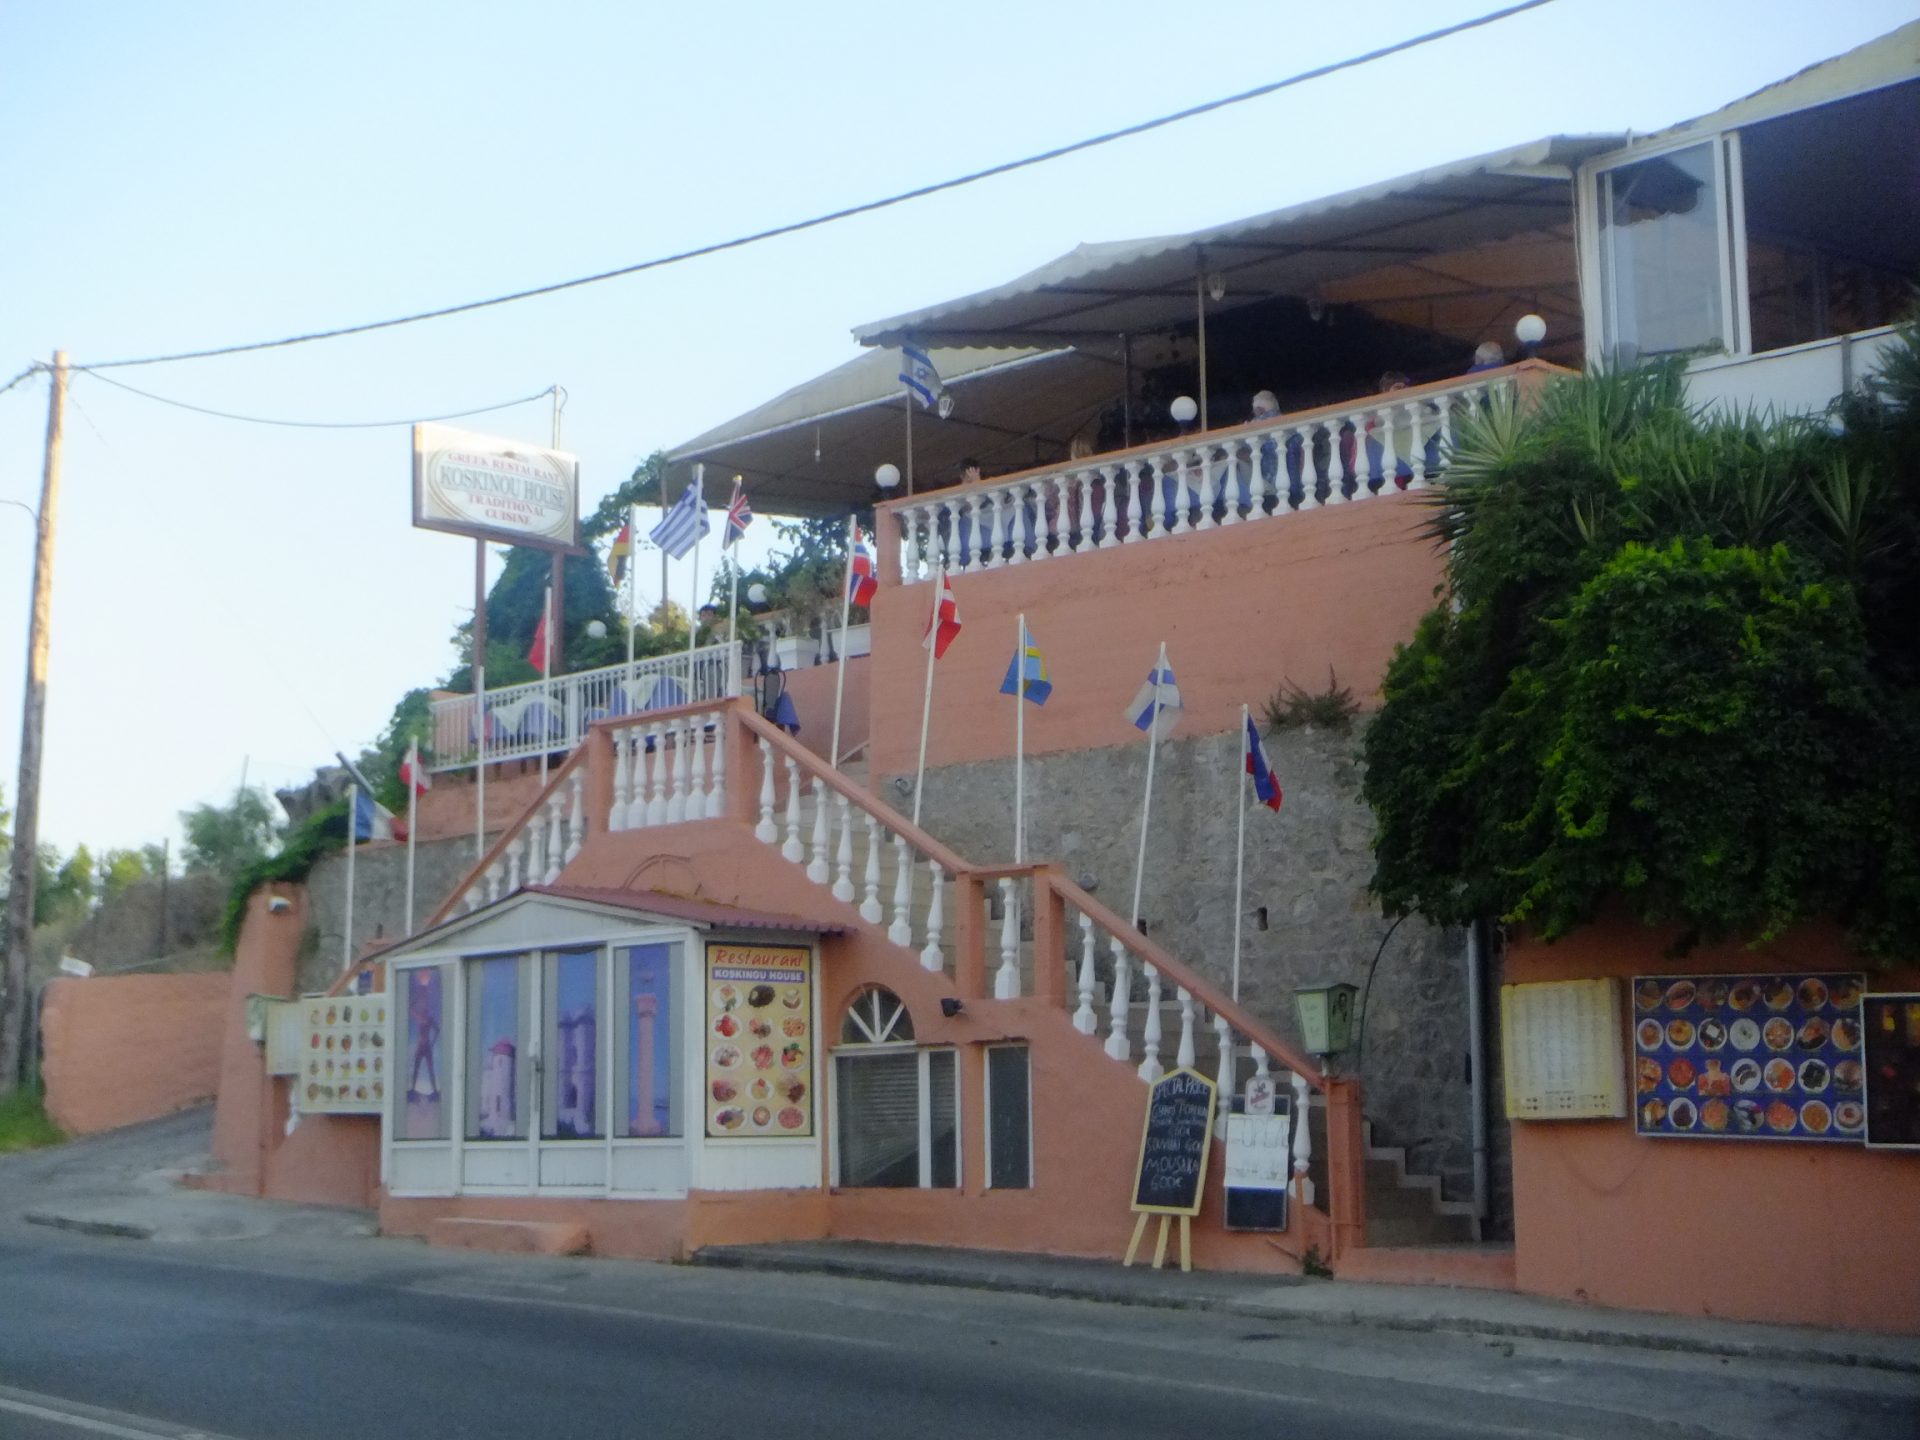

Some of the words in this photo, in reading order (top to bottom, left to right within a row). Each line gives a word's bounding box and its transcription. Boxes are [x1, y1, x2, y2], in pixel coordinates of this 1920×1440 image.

[447, 452, 489, 466] GREEK
[492, 459, 562, 482] RESTAURANT
[440, 465, 521, 496] KOSKINOU
[523, 480, 565, 507] HOUSE
[469, 493, 545, 517] TRADITIONAL
[485, 508, 530, 525] CUISINE
[715, 949, 804, 967] Restaurant
[714, 968, 767, 980] KOSKINOU
[769, 970, 803, 981] HOUSE
